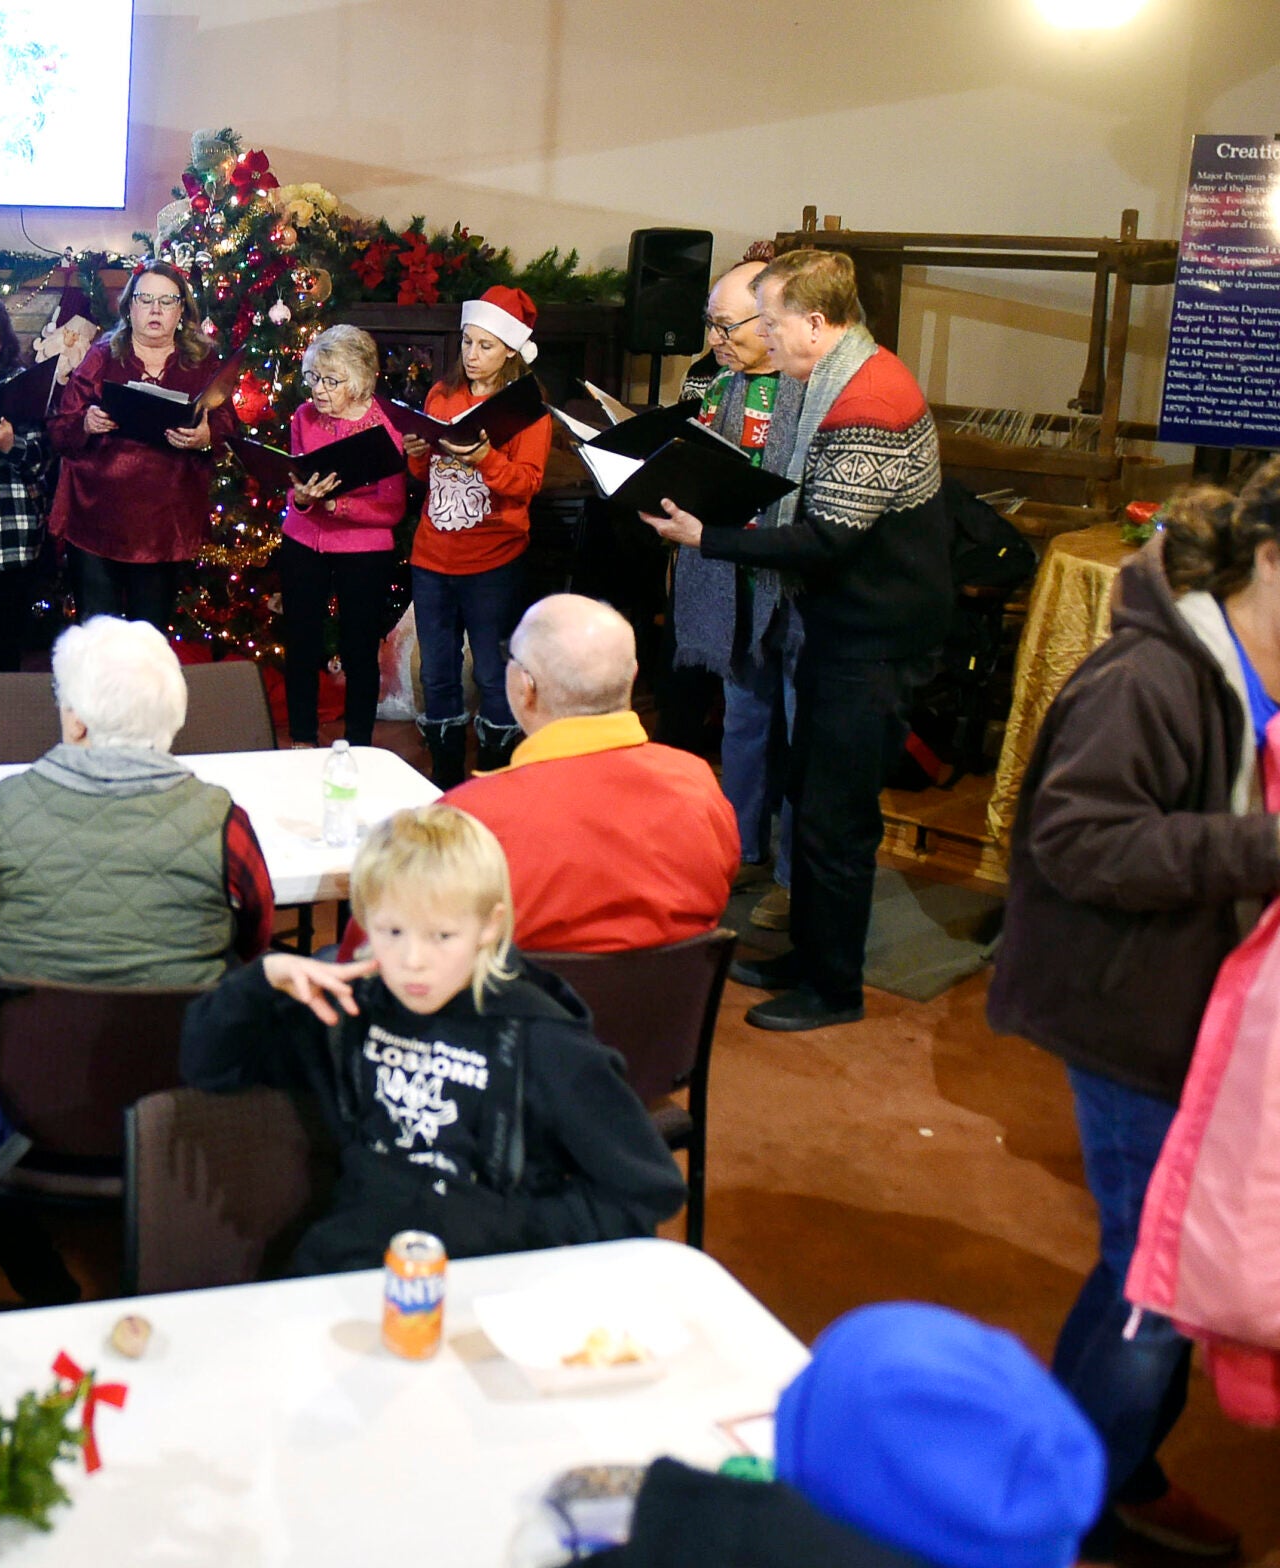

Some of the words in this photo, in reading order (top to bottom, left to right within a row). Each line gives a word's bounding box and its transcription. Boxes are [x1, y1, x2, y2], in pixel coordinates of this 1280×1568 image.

[1198, 171, 1223, 181] Major
[1225, 172, 1266, 182] Benjamin
[1192, 183, 1216, 192] Army
[1188, 207, 1220, 217] charity,
[1186, 219, 1229, 229] charitable
[1231, 221, 1248, 229] and
[1218, 243, 1269, 253] represented
[1201, 254, 1214, 263] the
[1181, 265, 1194, 274] the
[1196, 267, 1234, 276] direction
[1236, 269, 1245, 277] of
[1220, 280, 1235, 289] the
[1177, 301, 1192, 309] The
[1194, 302, 1240, 312] Minnesota
[1175, 313, 1205, 323] August
[1241, 317, 1255, 325] but
[1191, 325, 1200, 333] of
[1202, 326, 1216, 334] the
[1251, 329, 1276, 339] Many
[1183, 336, 1200, 344] find
[1202, 338, 1241, 348] members
[1182, 348, 1203, 357] GAR
[1205, 351, 1228, 359] posts
[1230, 353, 1273, 362] organized
[1168, 370, 1209, 380] Officially,
[1211, 373, 1241, 383] Mower
[1244, 375, 1276, 385] County
[1166, 382, 1191, 391] posts,
[1193, 383, 1204, 391] all
[1206, 384, 1242, 394] founded
[1244, 387, 1253, 395] in
[1255, 388, 1269, 396] the
[1166, 393, 1219, 405] membership
[1239, 399, 1265, 408] about
[1197, 406, 1213, 415] The
[1215, 409, 1231, 417] war
[1233, 408, 1249, 417] still
[1163, 415, 1172, 423] to
[1174, 415, 1189, 424] feel
[1190, 418, 1242, 429] comfortable
